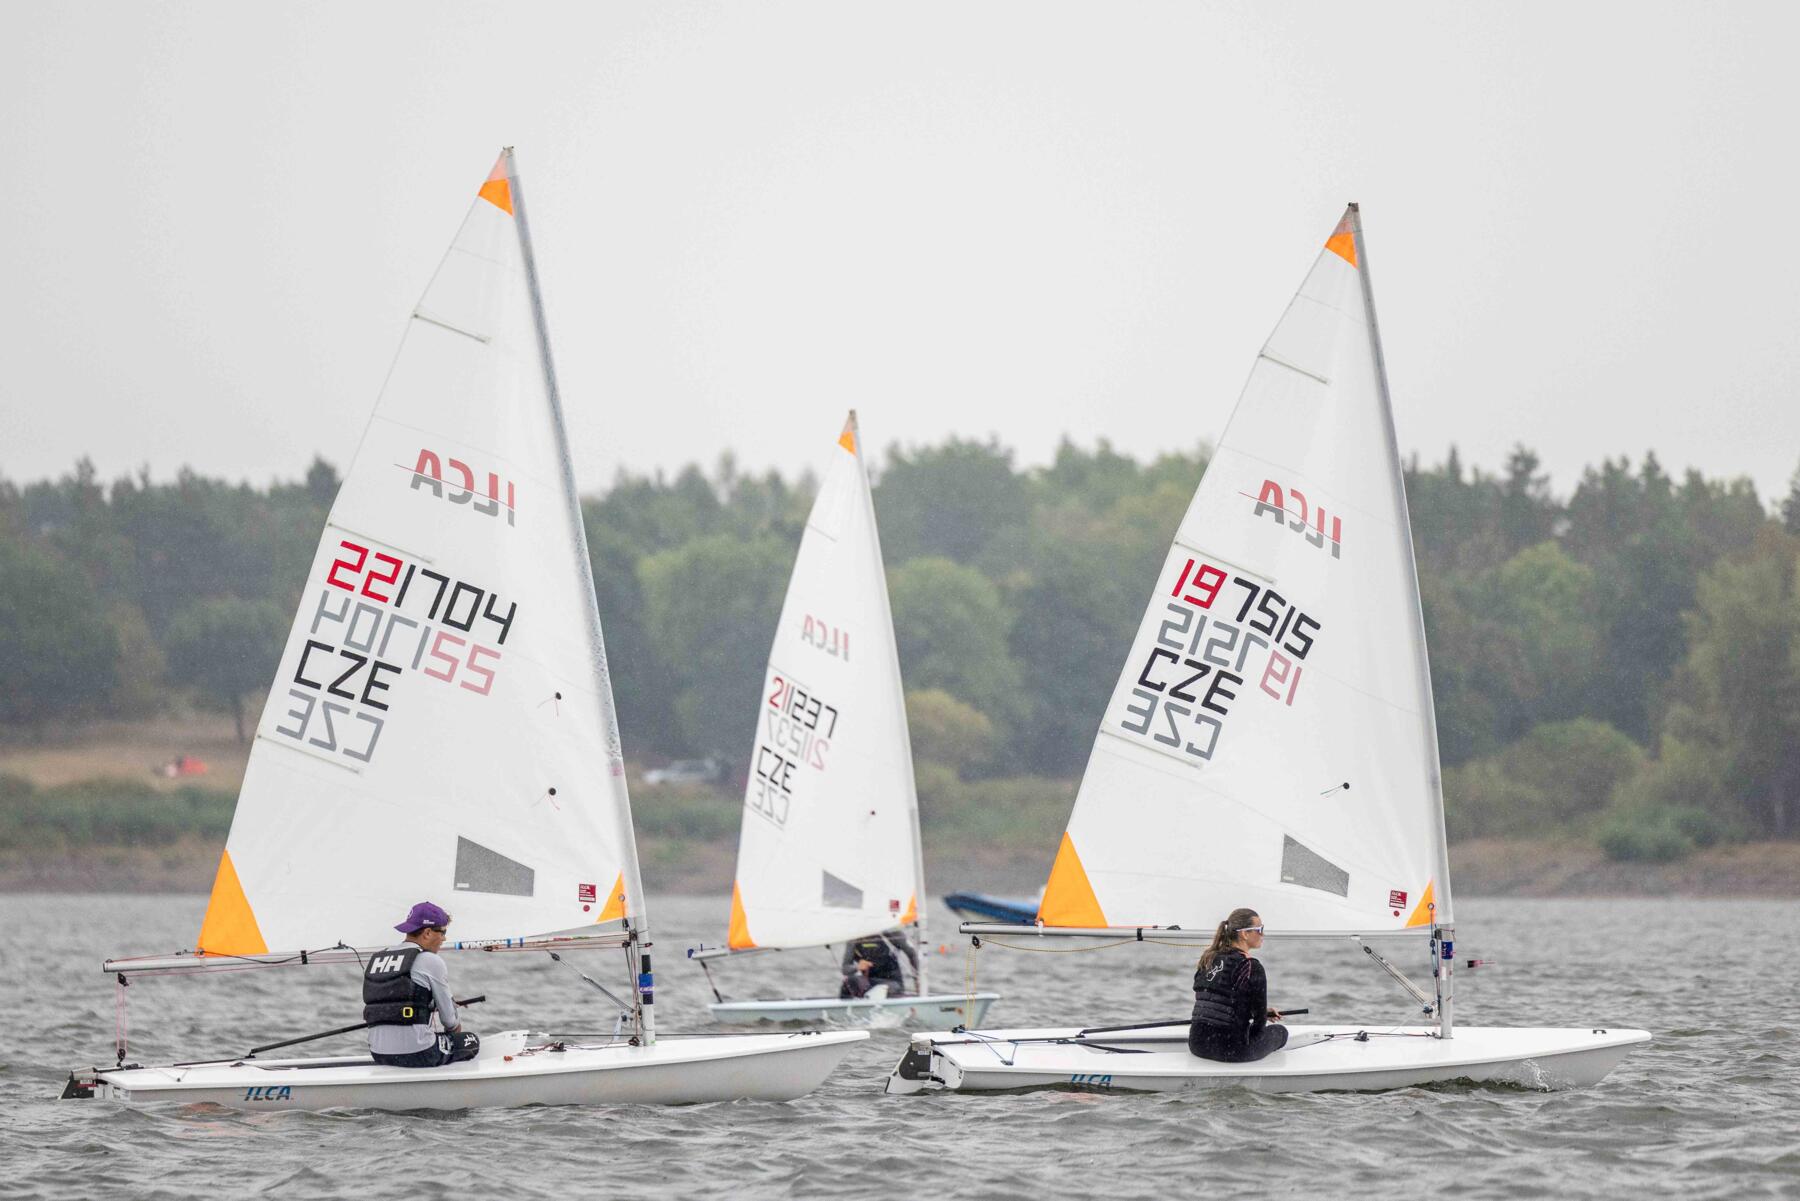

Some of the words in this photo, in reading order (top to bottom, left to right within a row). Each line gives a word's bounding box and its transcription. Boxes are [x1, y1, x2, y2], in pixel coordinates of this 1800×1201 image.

[327, 540, 517, 645] 221704
[1171, 558, 1321, 660] 197515
[294, 639, 402, 711] CZE
[1137, 647, 1244, 716] CZE
[757, 746, 796, 794] CZE
[370, 954, 405, 974] HH
[244, 1086, 290, 1101] ILCA
